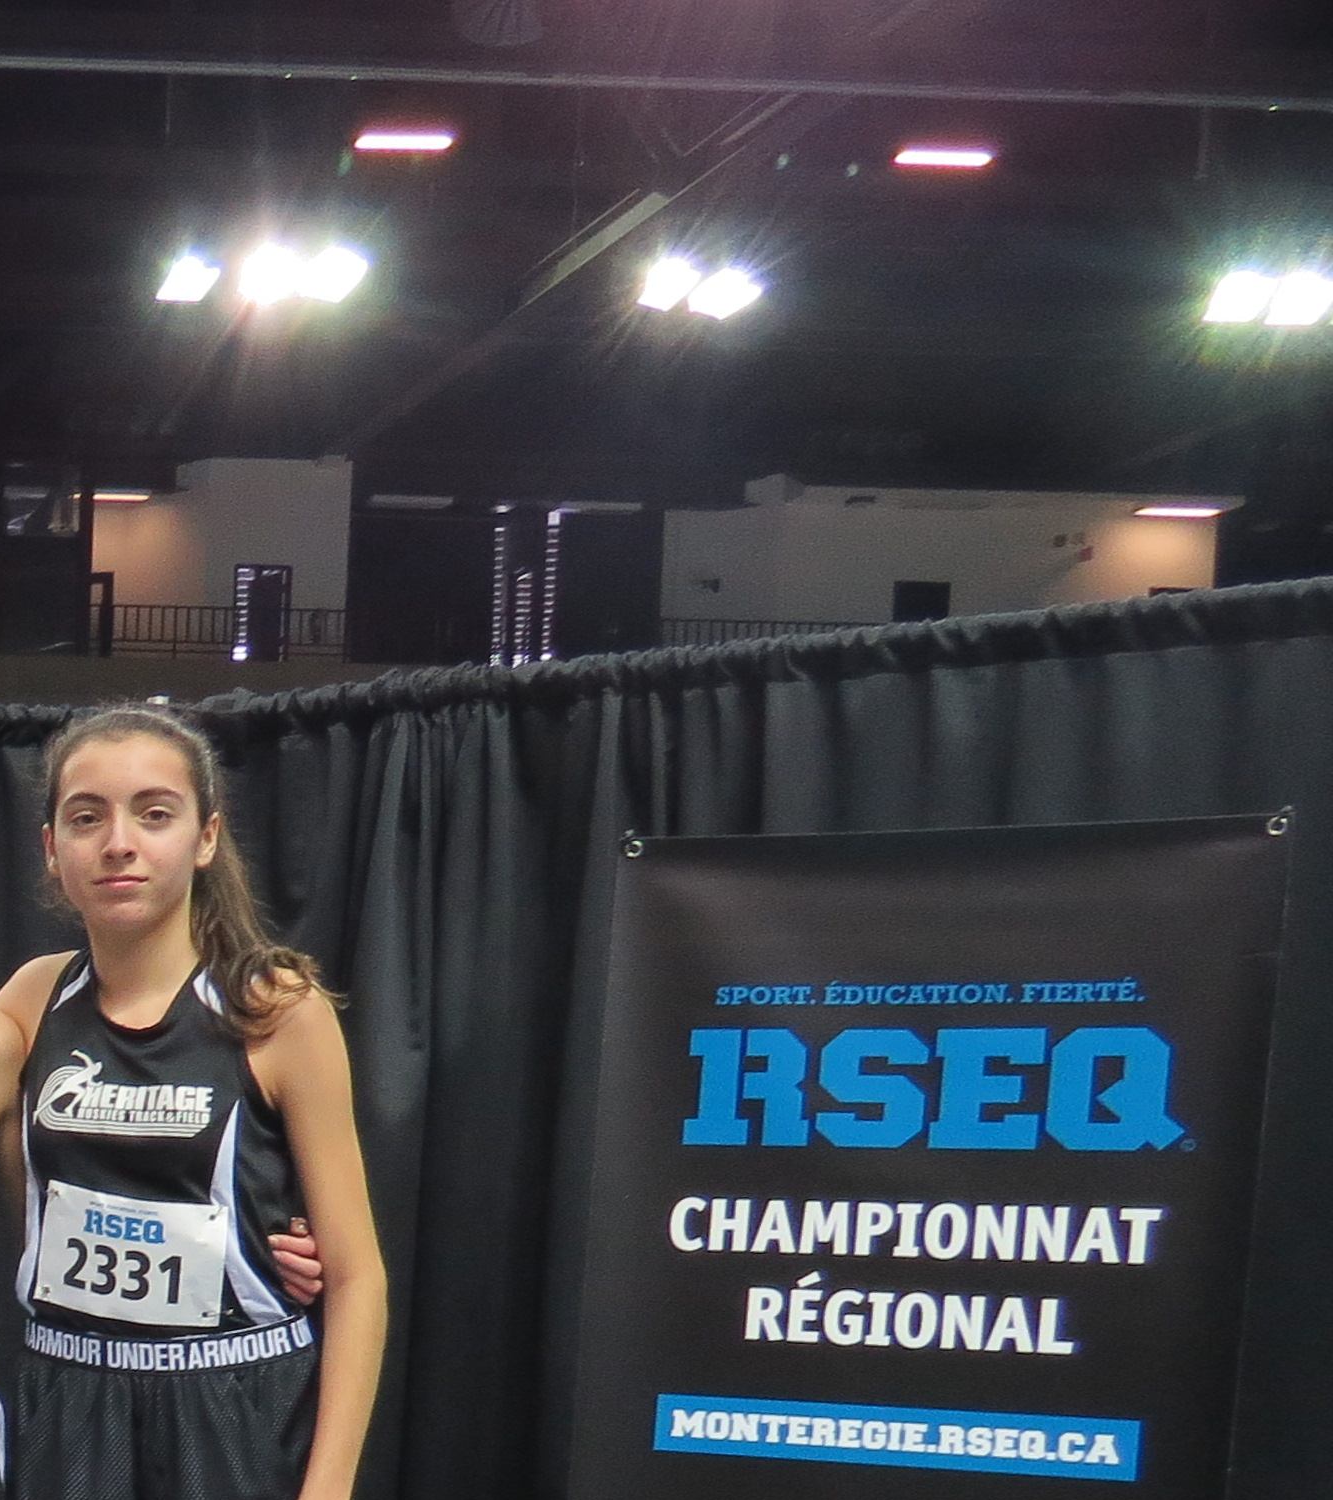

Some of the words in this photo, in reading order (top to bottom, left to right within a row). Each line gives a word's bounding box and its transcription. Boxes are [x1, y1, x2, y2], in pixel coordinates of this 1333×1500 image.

[715, 985, 818, 1006] SPORT.
[824, 980, 1012, 1004] ÉDUCATION.
[1021, 976, 1144, 1004] FIERTÉ.
[82, 1083, 213, 1112] HERITAGE
[682, 1027, 1186, 1152] RSEQ
[84, 1209, 165, 1244] RSEQ
[668, 1196, 1161, 1264] CHAMPIONNAT
[63, 1238, 183, 1305] 2331
[744, 1271, 1074, 1354] RÉGIONAL
[669, 1407, 1119, 1466] MONTEREGIE.RSEQ.CA
